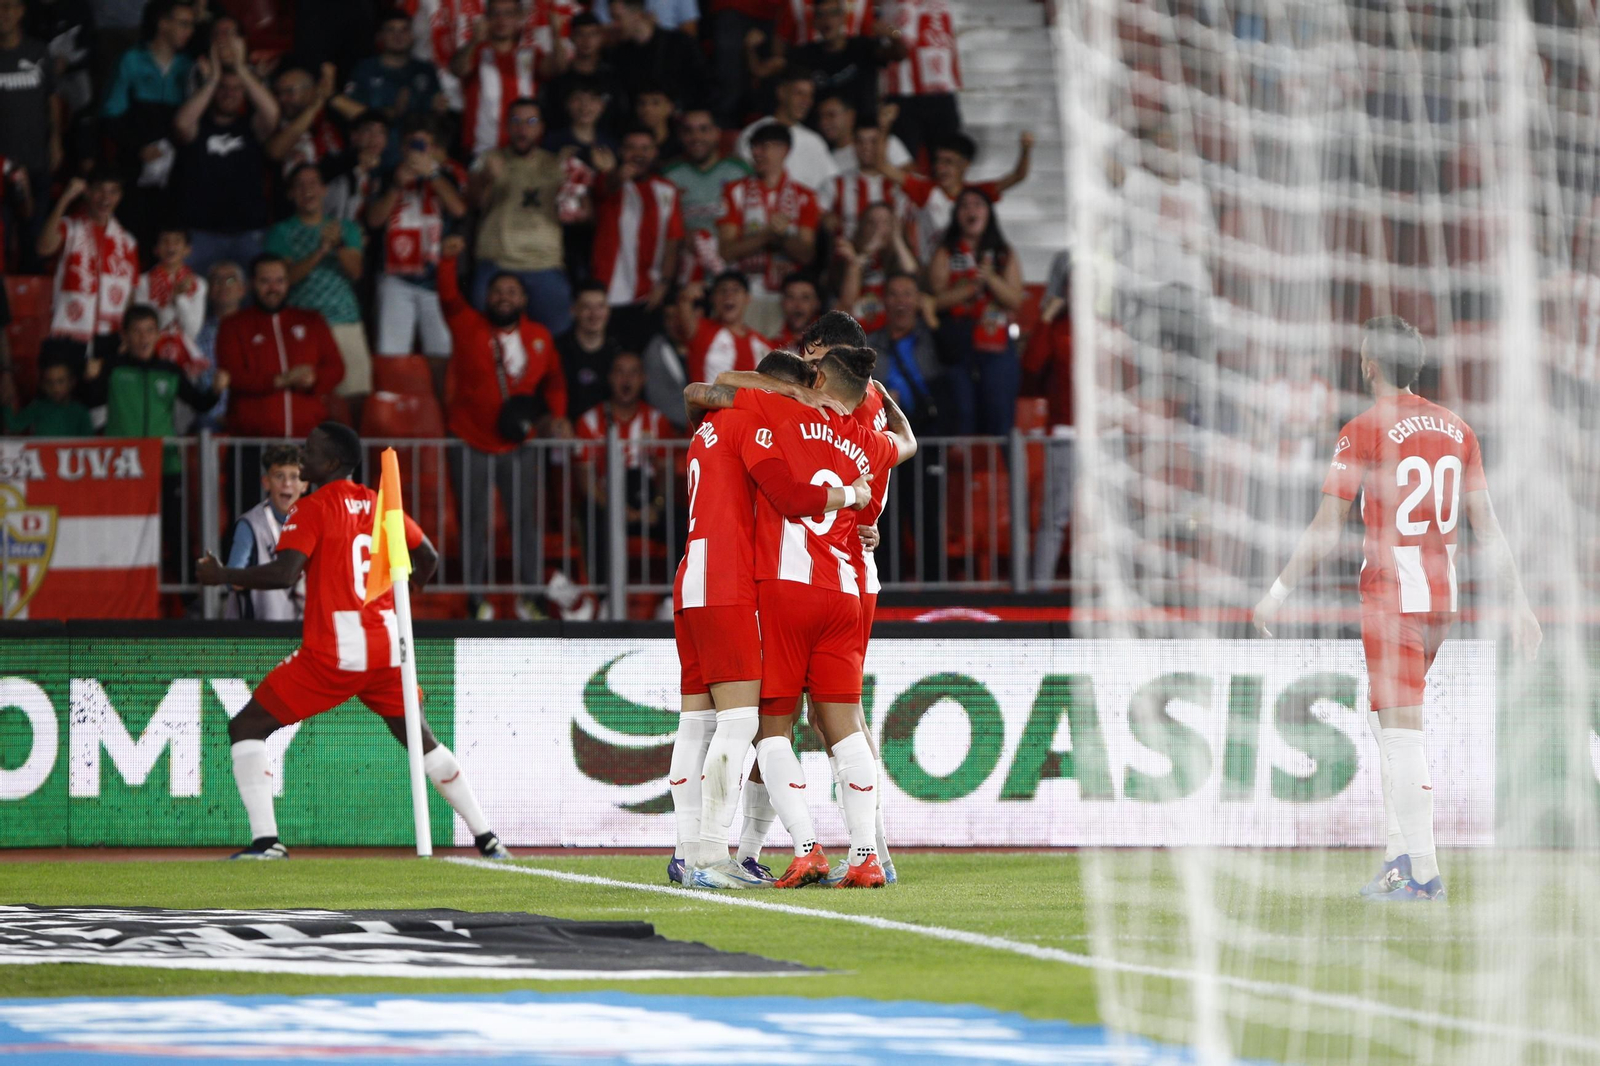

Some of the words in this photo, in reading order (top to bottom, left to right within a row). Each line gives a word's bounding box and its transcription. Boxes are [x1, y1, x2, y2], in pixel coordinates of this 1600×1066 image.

[799, 422, 834, 444] LUIS
[1387, 415, 1464, 444] CENTELLES
[56, 446, 145, 482] UVA
[1395, 455, 1462, 536] 20
